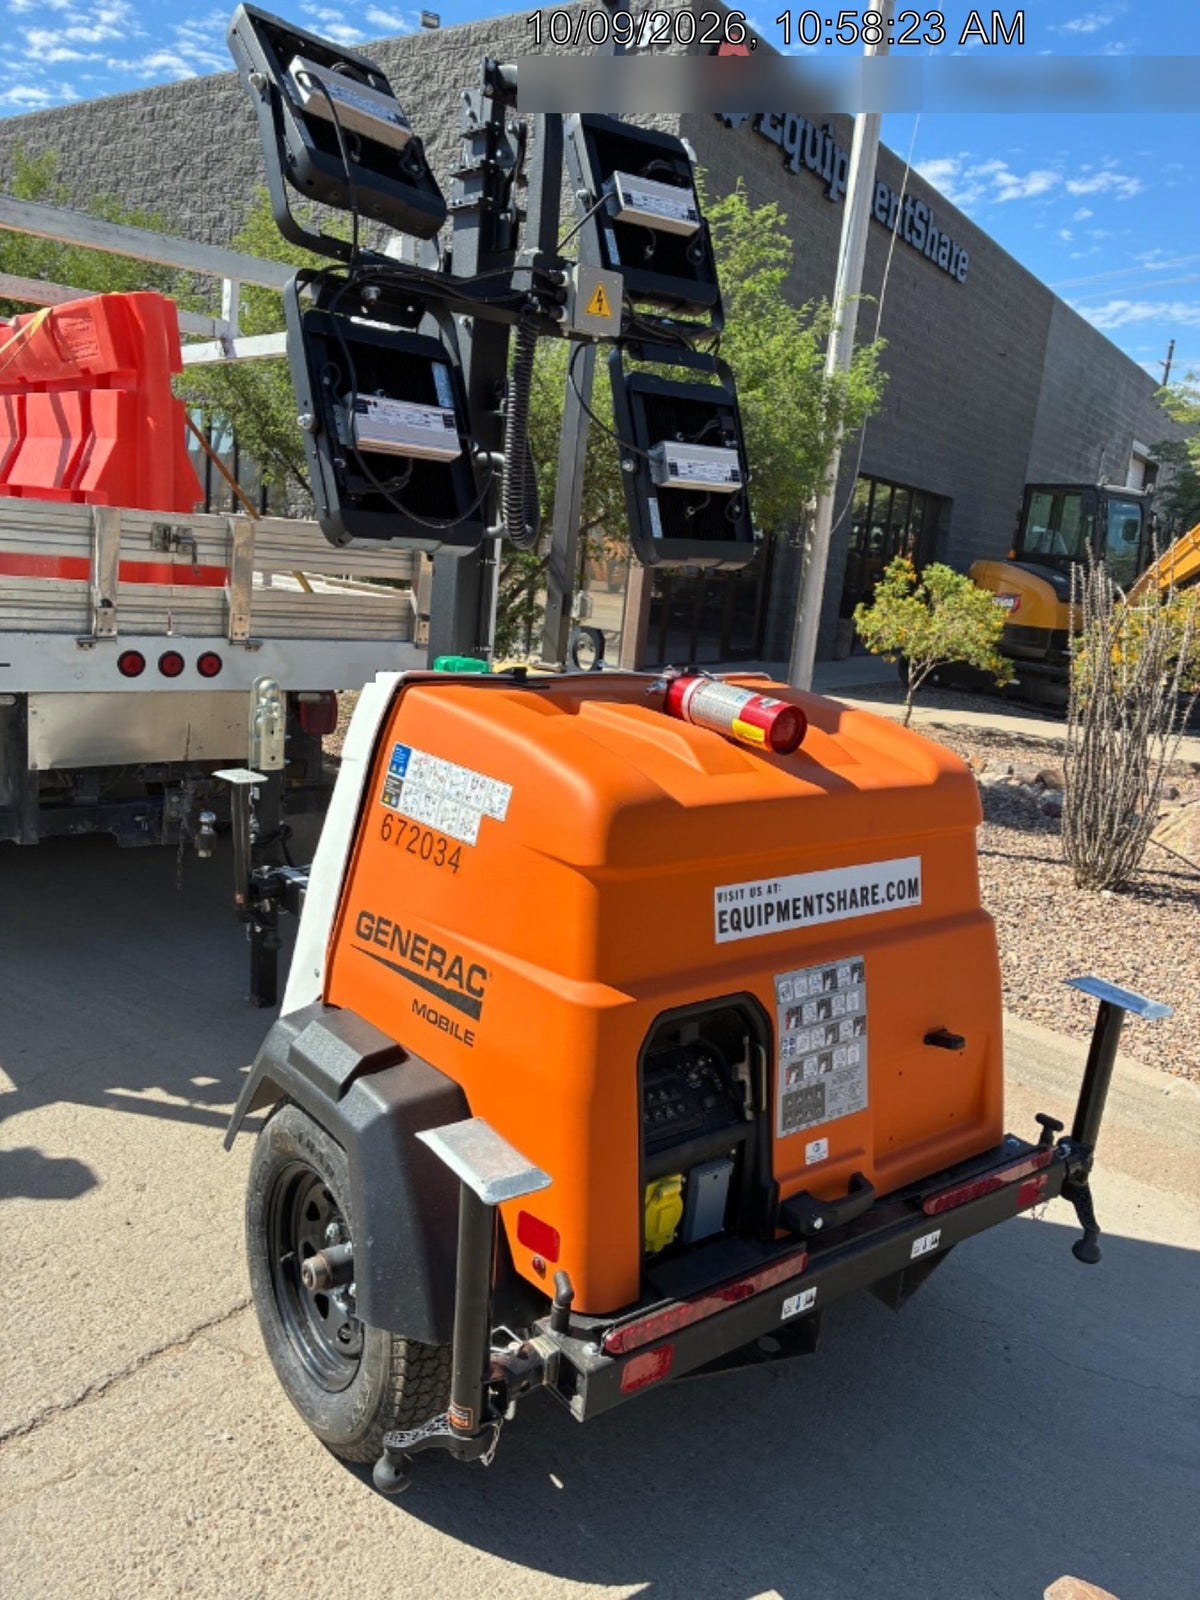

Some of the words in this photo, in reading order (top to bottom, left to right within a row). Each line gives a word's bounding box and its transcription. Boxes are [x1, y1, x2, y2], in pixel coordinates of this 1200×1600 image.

[756, 112, 969, 283] quipentShare
[380, 813, 462, 874] 672034
[717, 888, 745, 904] VISIT
[749, 886, 762, 898] US
[766, 883, 782, 894] AT:
[717, 877, 919, 934] EQUIPMENTSHARE.COM
[355, 909, 488, 998] GENERAC
[411, 998, 476, 1048] MOBILE
